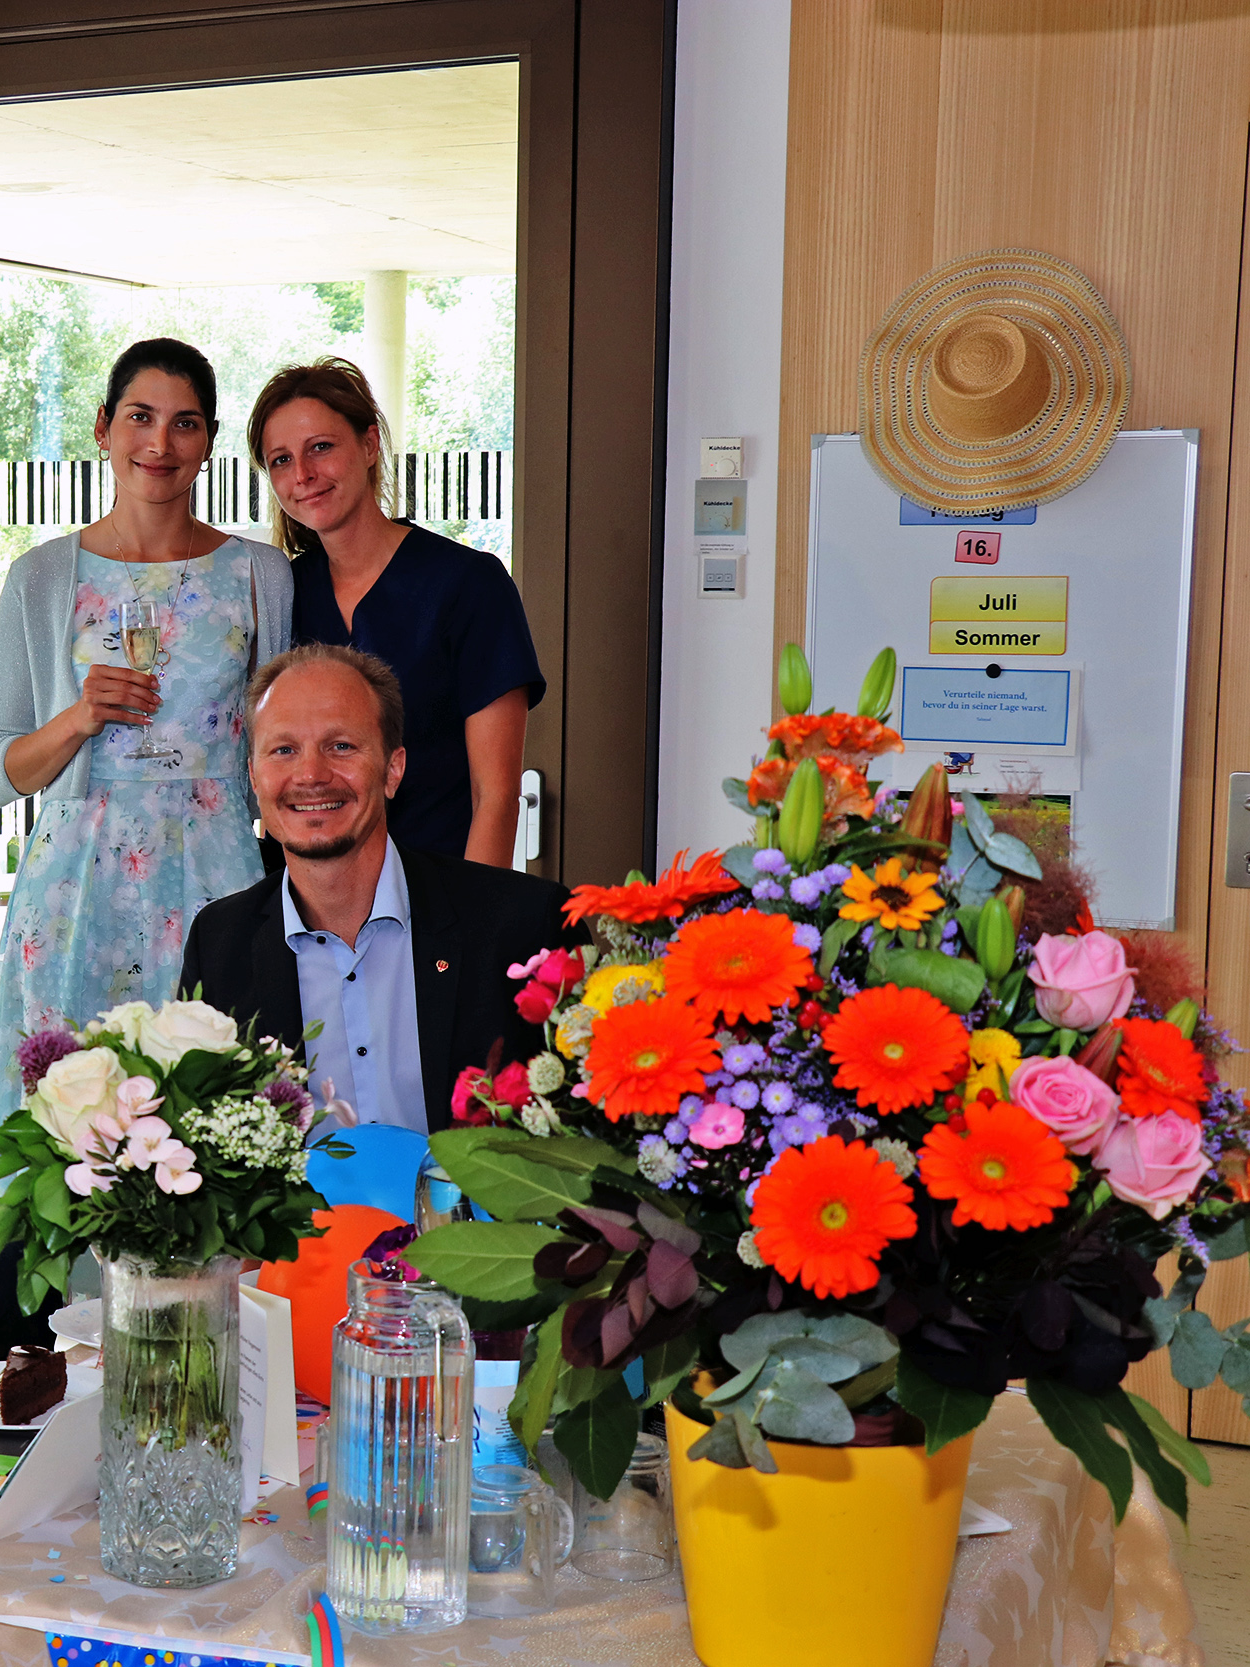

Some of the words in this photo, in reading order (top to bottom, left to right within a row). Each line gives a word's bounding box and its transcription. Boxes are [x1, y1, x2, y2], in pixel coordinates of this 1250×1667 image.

[963, 538, 992, 557] 16.
[978, 593, 1017, 611] Juli
[954, 629, 1041, 646] Sommer
[943, 689, 986, 699] Verurteile
[987, 691, 1028, 701] niemand,
[922, 700, 946, 709] bevor
[947, 701, 959, 710] du
[961, 701, 970, 710] in
[971, 702, 997, 711] seiner
[999, 702, 1019, 713] Lage
[1020, 703, 1047, 712] warst.
